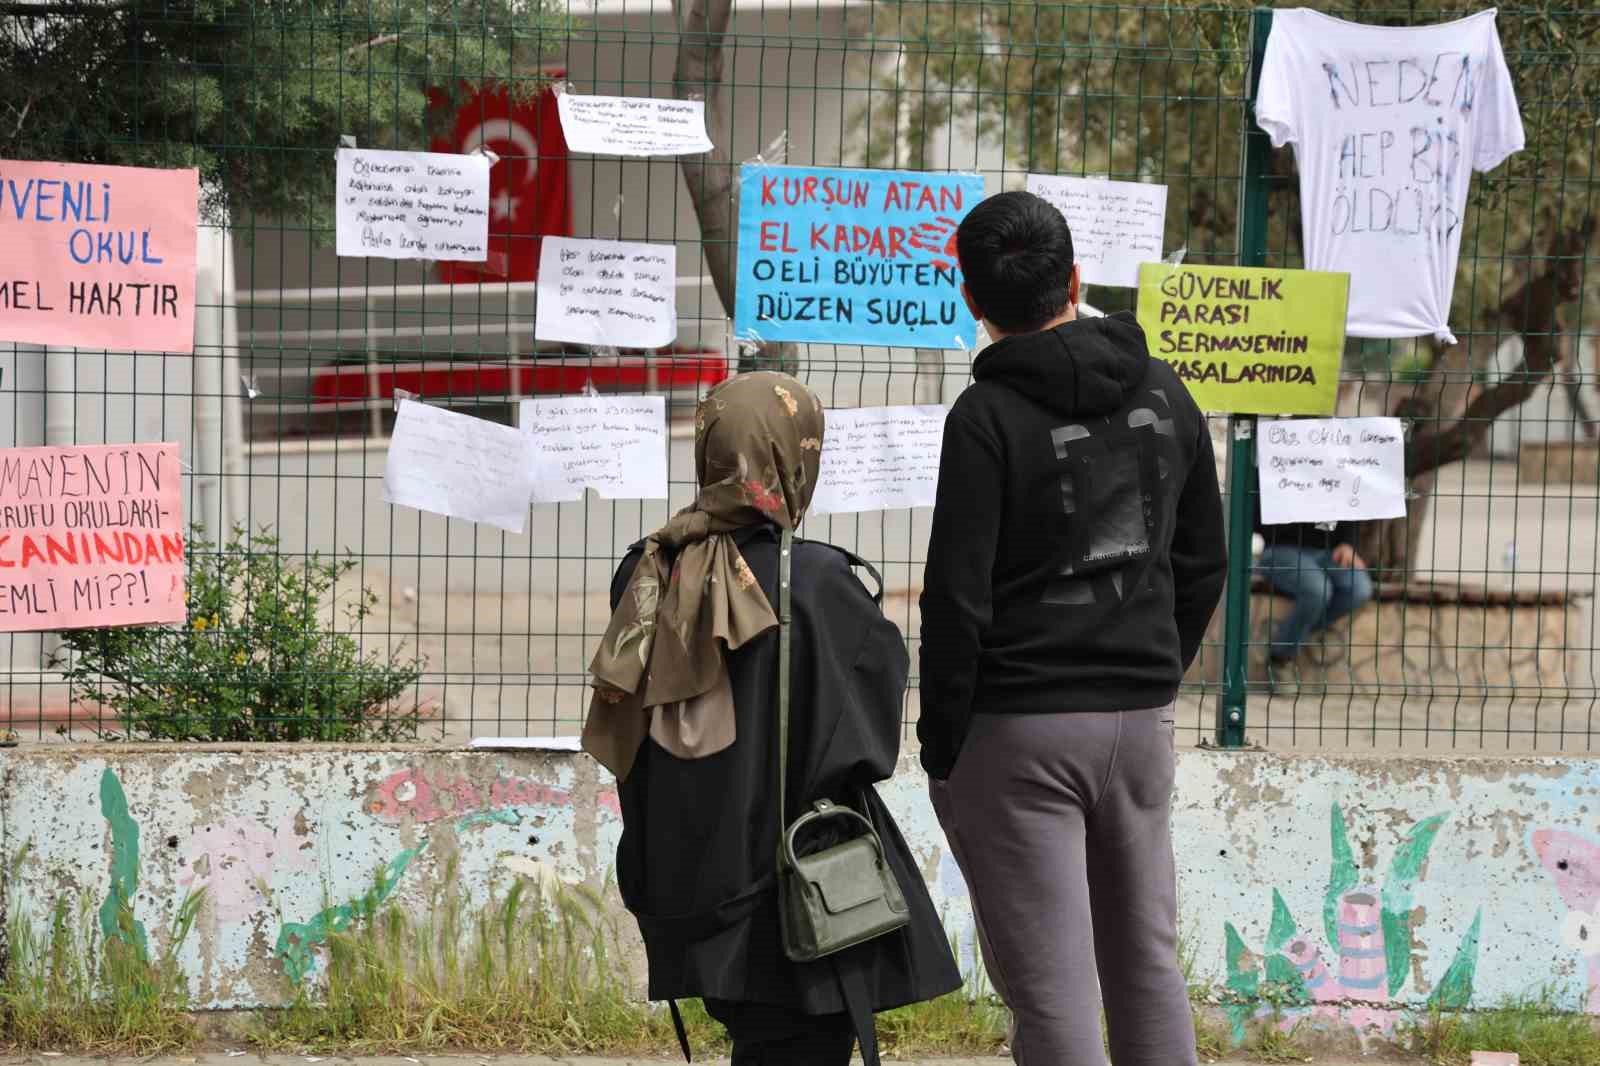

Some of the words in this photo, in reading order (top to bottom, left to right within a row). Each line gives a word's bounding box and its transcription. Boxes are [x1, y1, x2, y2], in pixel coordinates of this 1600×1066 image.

[1322, 52, 1475, 113] NEDEN
[1339, 130, 1395, 180] HEP
[0, 178, 110, 223] VENLİ
[761, 175, 869, 212] KURŞUN
[883, 180, 963, 213] ATAN
[69, 228, 163, 265] OKUL
[759, 221, 799, 253] EL
[810, 222, 913, 259] KADAR
[834, 257, 956, 288] BÜYÜTEN
[1161, 271, 1283, 301] GÜVENLİK
[69, 281, 178, 318] HAKTIR
[756, 291, 853, 324] DÜZEN
[866, 297, 956, 332] SUÇLU
[0, 451, 165, 499] MAYENİN
[0, 503, 54, 528] RUFU
[64, 500, 169, 529] OKULDAKİ-
